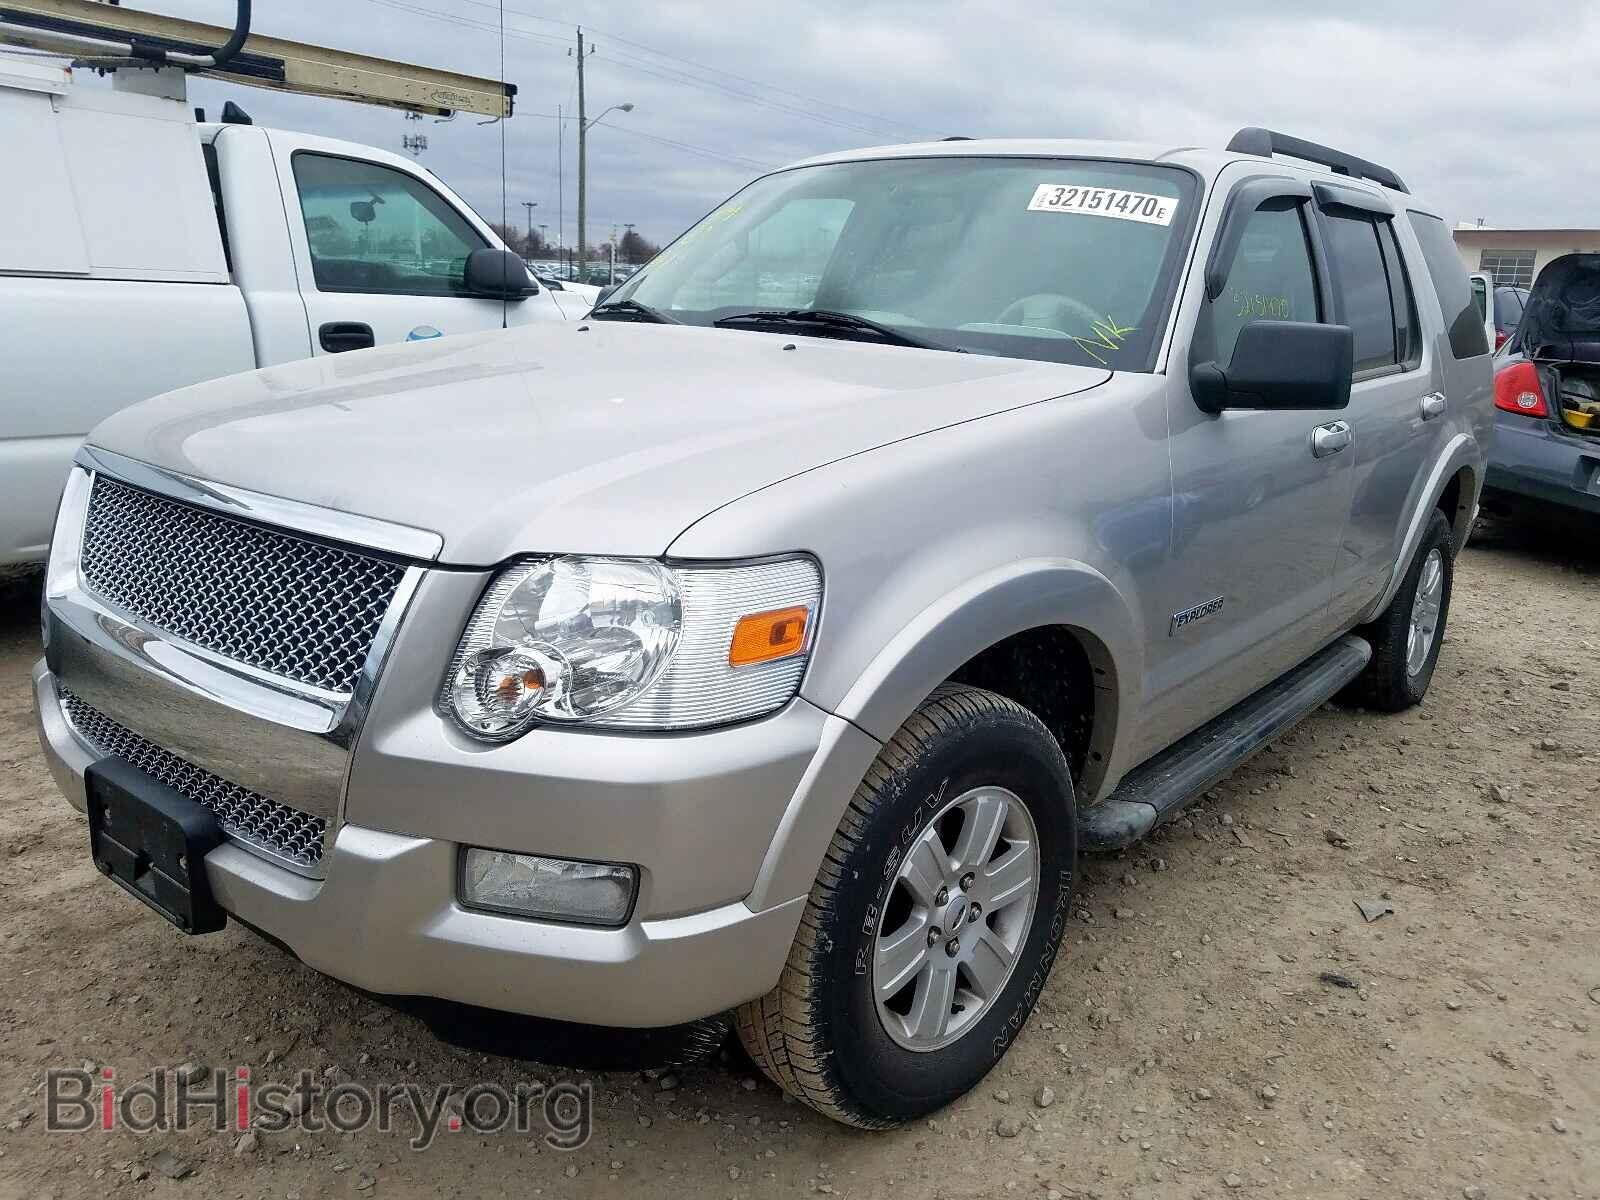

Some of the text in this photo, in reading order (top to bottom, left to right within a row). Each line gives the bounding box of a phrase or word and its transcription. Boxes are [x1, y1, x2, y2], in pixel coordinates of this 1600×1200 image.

[1049, 187, 1158, 217] 32151470
[1156, 207, 1167, 219] E
[1072, 314, 1137, 365] NK
[1174, 598, 1224, 628] EXPLORER
[993, 870, 1073, 1058] IRONMAN
